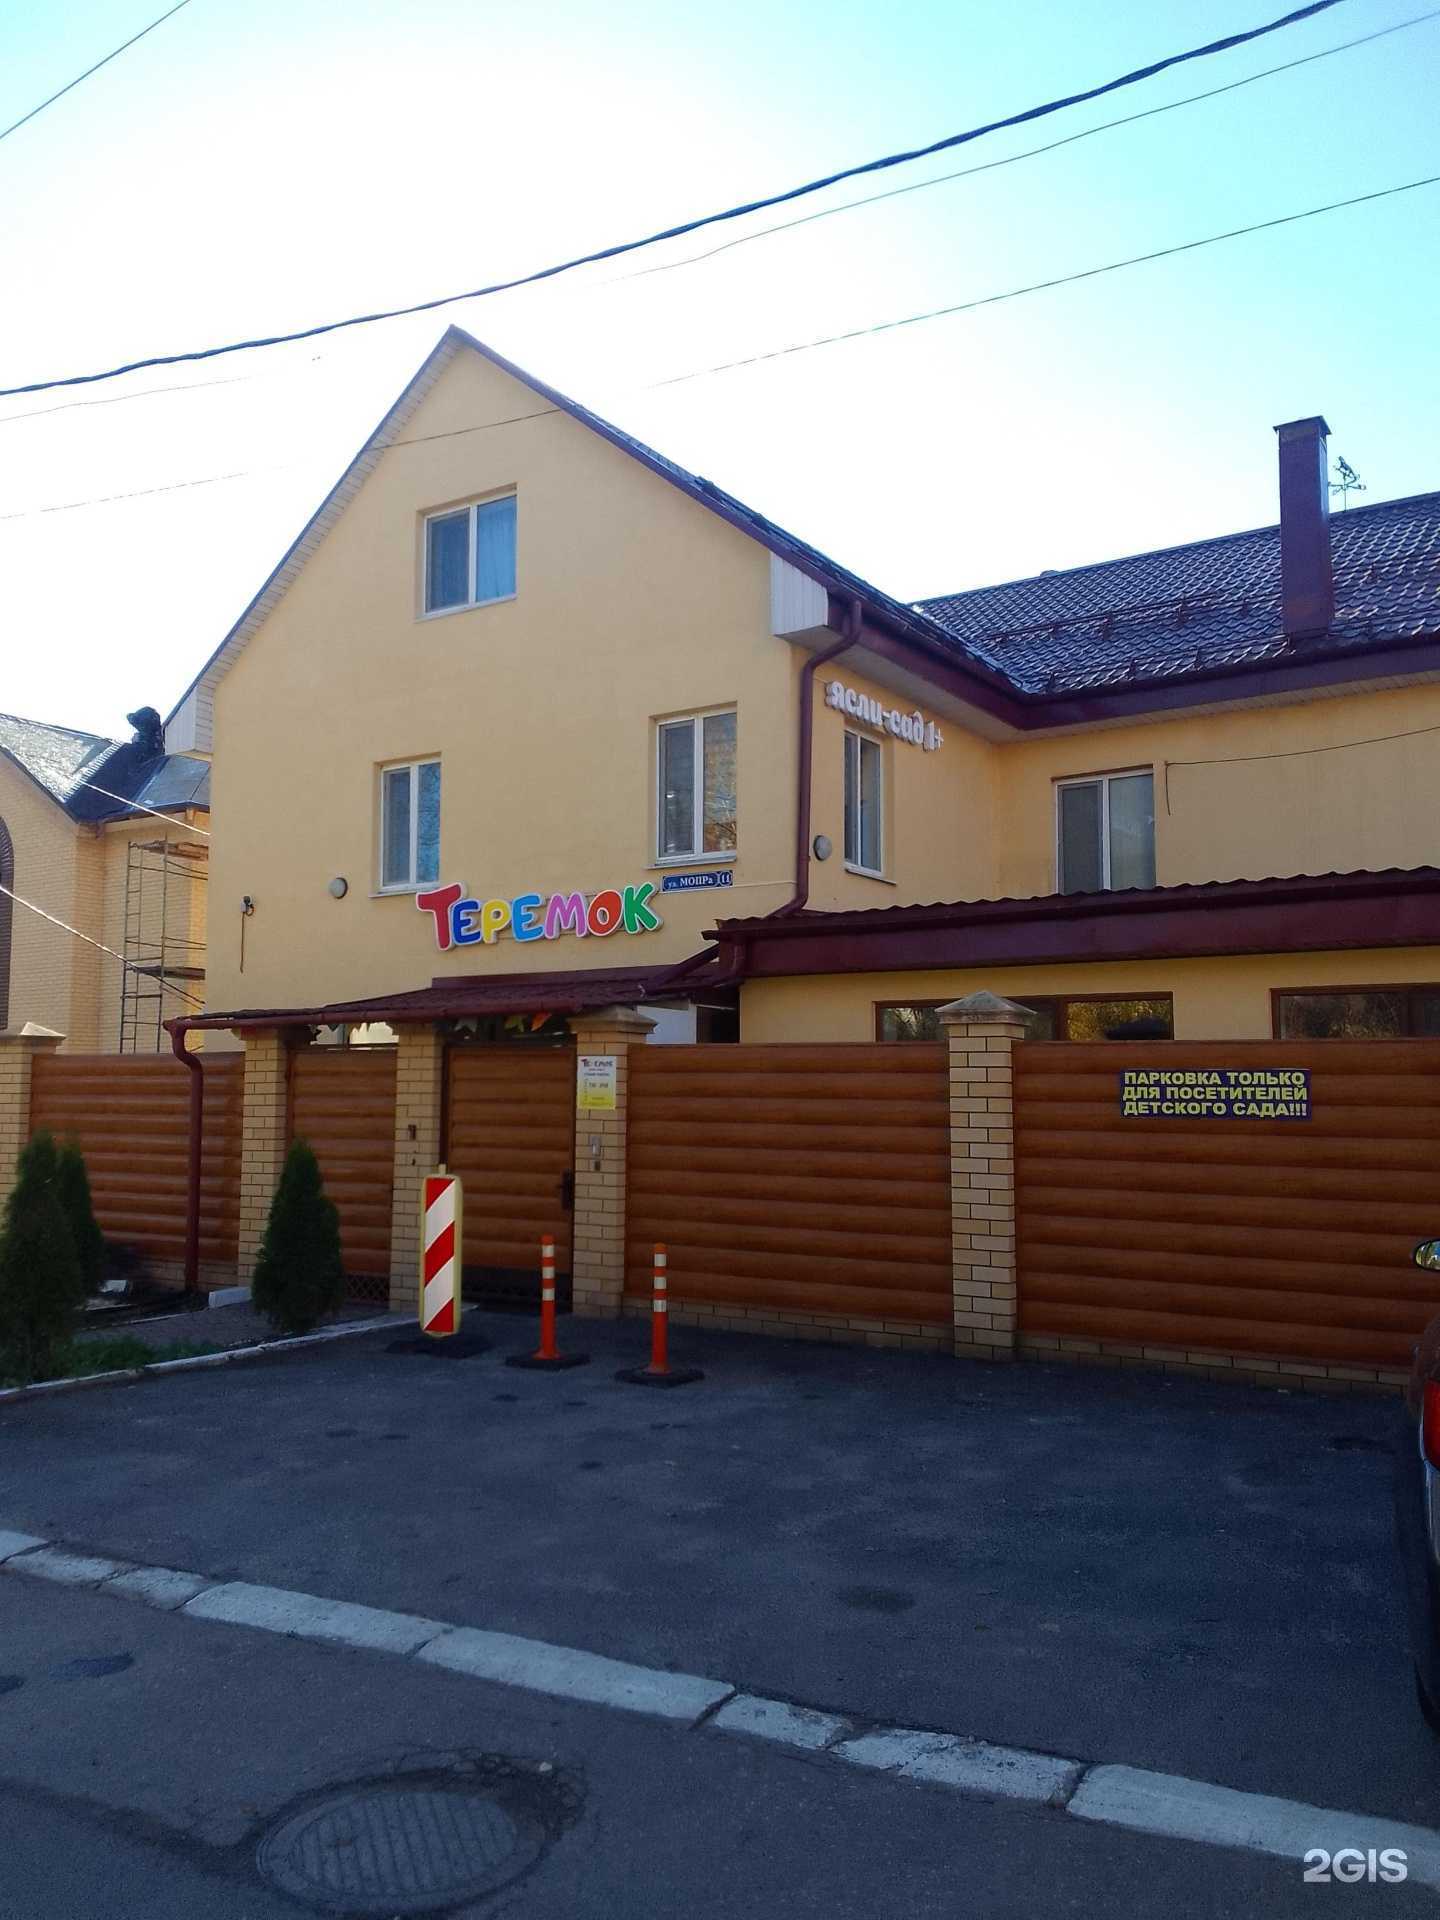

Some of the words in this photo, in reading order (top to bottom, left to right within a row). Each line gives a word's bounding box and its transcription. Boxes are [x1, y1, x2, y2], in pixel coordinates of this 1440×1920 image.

[416, 882, 661, 951] ТЕРЕМОК
[1124, 1072, 1222, 1085] ПАРКОВКА
[1226, 1072, 1305, 1085] ТОЛЬКО
[1123, 1087, 1160, 1100] ДЛЯ
[1166, 1086, 1307, 1100] ПОСЕТИТЕЛЕЙ
[1123, 1102, 1227, 1115] ДЕТСКОГО
[1232, 1103, 1307, 1117] САДА!!!
